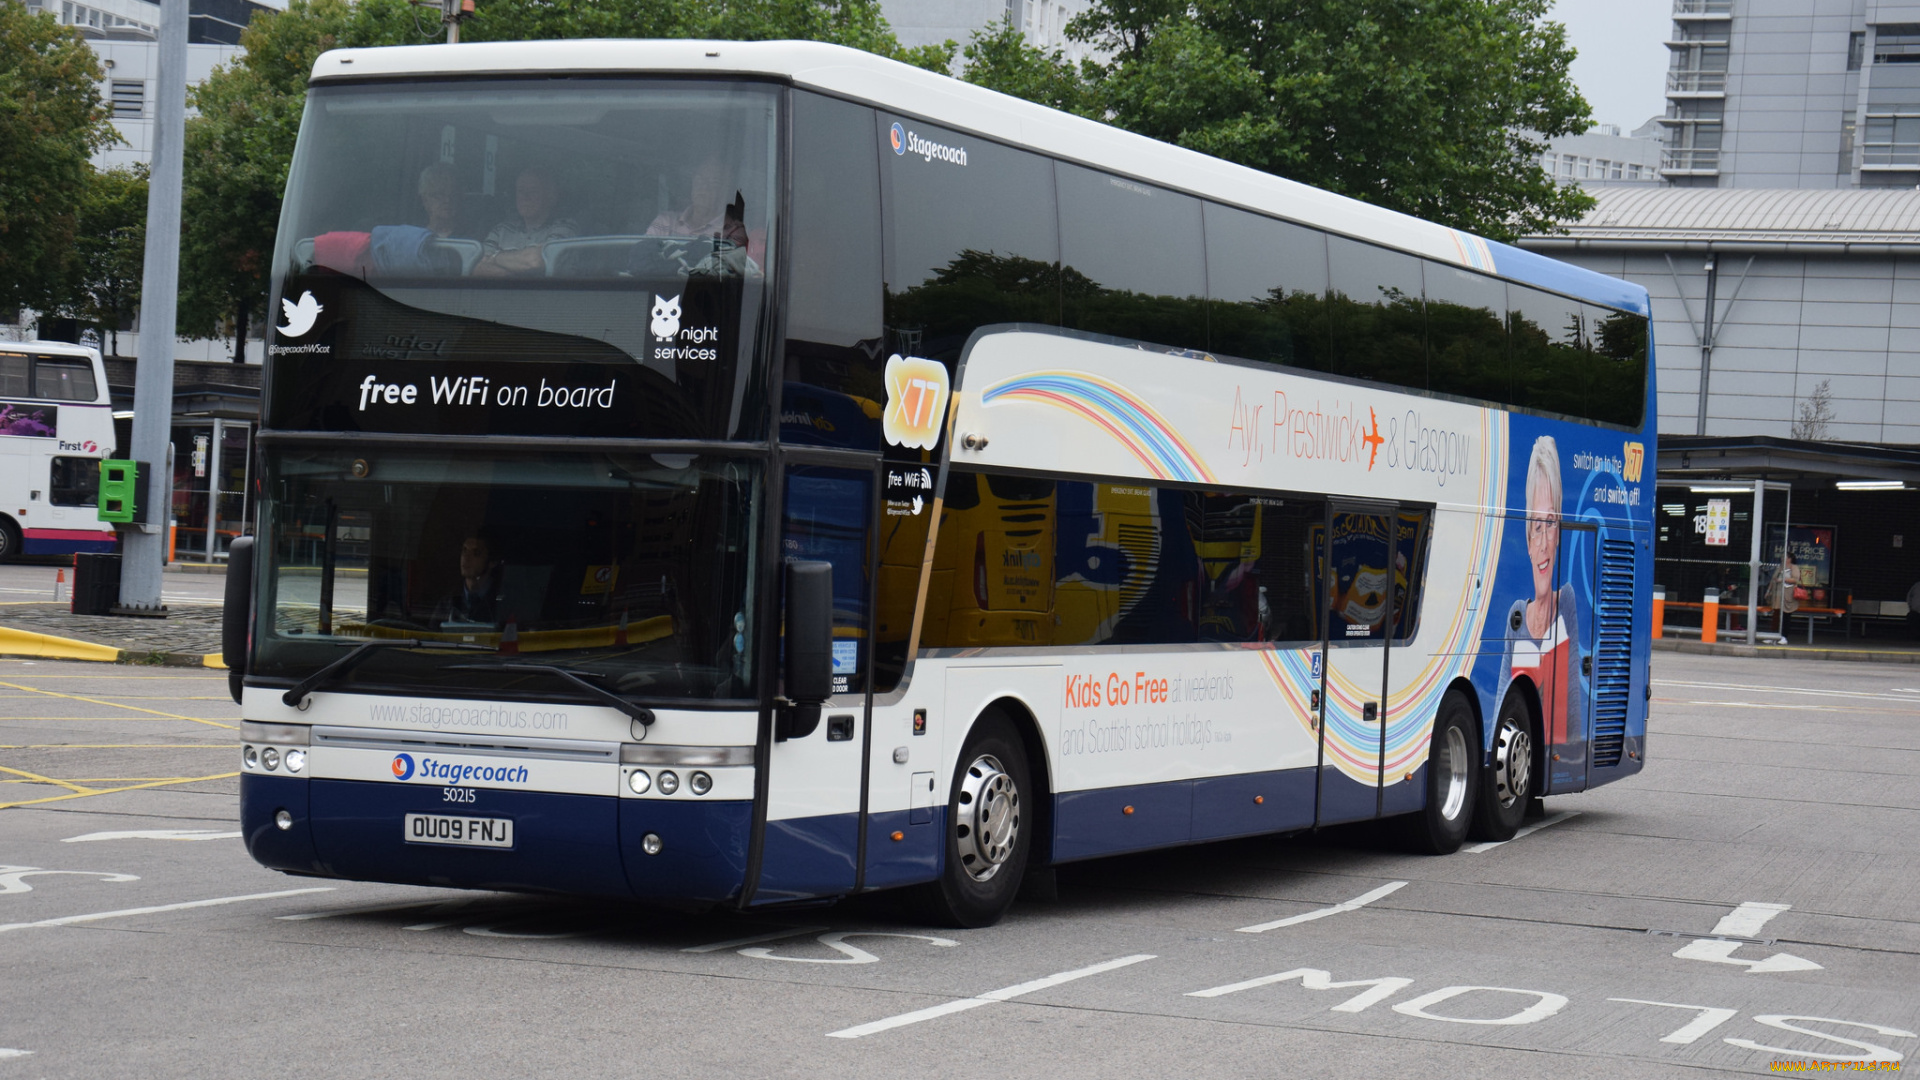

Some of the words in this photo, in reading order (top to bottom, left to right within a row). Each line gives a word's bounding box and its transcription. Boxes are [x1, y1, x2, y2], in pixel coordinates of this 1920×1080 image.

[907, 130, 967, 166] Stagecoach
[680, 326, 718, 343] night
[654, 346, 717, 360] services
[358, 374, 418, 411] free
[430, 376, 490, 406] WiFi
[497, 385, 528, 406] on
[537, 378, 616, 409] board
[892, 376, 941, 429] X77
[59, 440, 82, 452] First
[1228, 385, 1264, 467] Ayr,
[1273, 390, 1360, 463] Prestwick
[1387, 417, 1400, 468] &
[1403, 409, 1471, 487] Glasgow
[1573, 450, 1594, 470] switch
[1594, 455, 1603, 472] on
[1604, 454, 1611, 473] to
[1611, 454, 1622, 474] the
[887, 470, 903, 489] free
[904, 471, 921, 488] WiFi
[1594, 484, 1607, 503] and
[1607, 485, 1629, 506] switch
[1692, 514, 1707, 534] 18
[833, 676, 848, 685] CLEAR
[1065, 674, 1101, 709] Kids
[1106, 672, 1130, 706] Go
[1134, 671, 1168, 704] Free
[1171, 673, 1182, 703] at
[1184, 669, 1234, 703] weekends
[369, 702, 568, 730] www.stagecoachbus.com
[1062, 720, 1086, 756] and
[1088, 717, 1132, 754] Scottish
[1134, 714, 1170, 750] school
[1172, 711, 1212, 751] holidays
[420, 757, 529, 785] Stagecoach
[442, 787, 476, 803] 50215
[413, 816, 463, 840] OU09
[468, 819, 506, 842] FNJ
